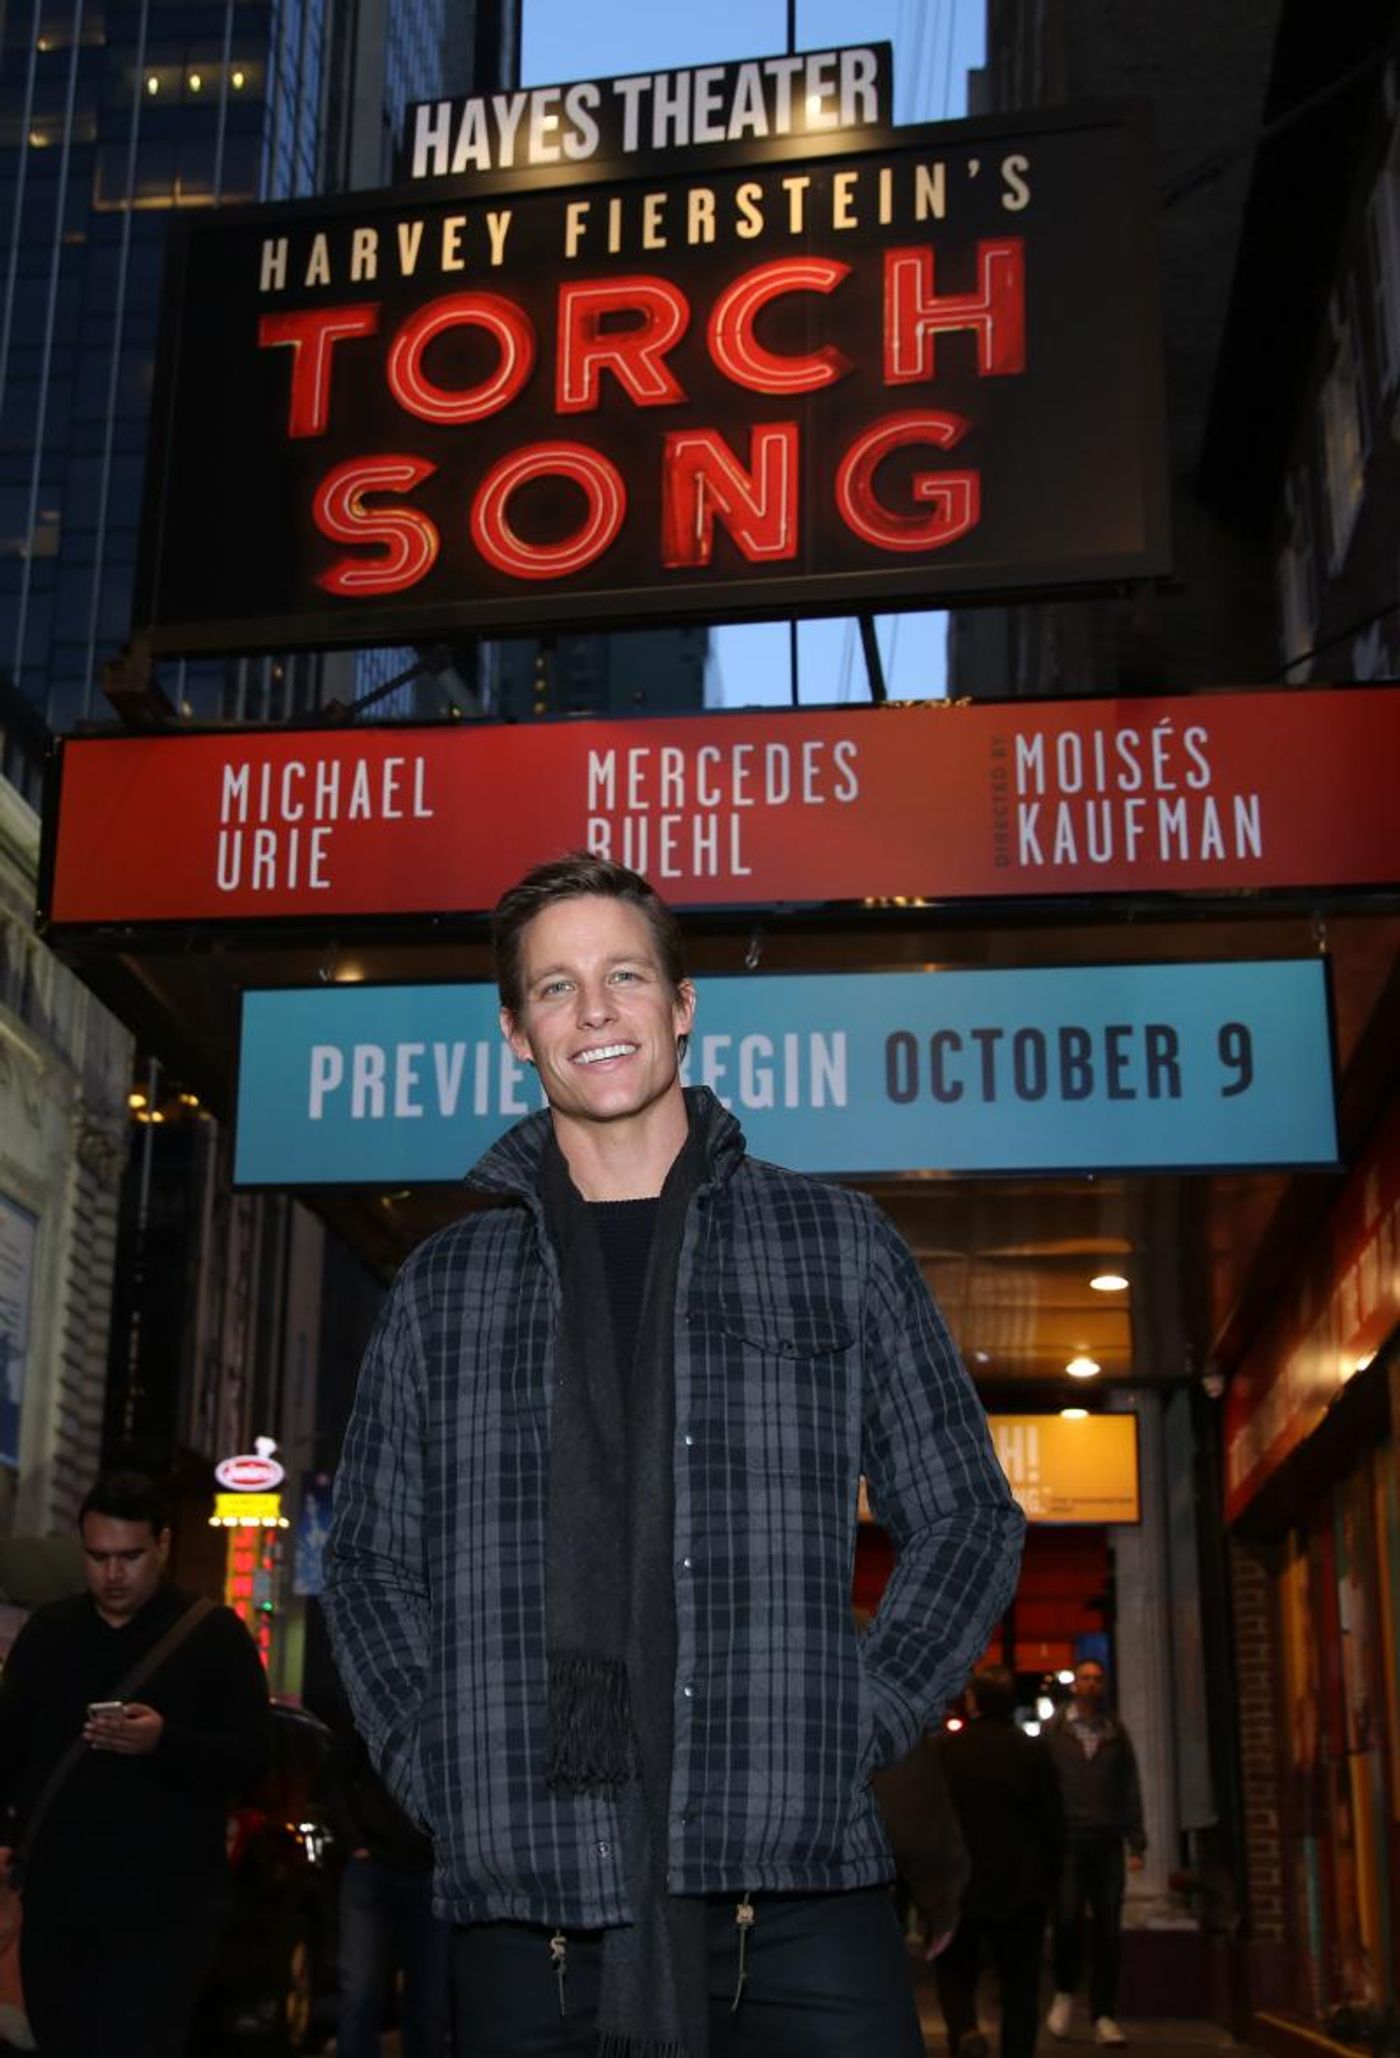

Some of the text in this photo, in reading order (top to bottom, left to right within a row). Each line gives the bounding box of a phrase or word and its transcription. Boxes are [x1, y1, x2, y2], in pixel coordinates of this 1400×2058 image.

[411, 48, 878, 179] HAYES THEATER
[259, 211, 511, 292] HARVEY
[258, 236, 1026, 439] TORCH
[312, 409, 981, 596] SONG
[219, 756, 433, 823] MICHAEL
[586, 740, 860, 811] MERCEDES
[1015, 718, 1212, 796] MOISÉS
[216, 826, 333, 890] URIE
[1018, 794, 1263, 866] KAUFMAN
[308, 1040, 551, 1120] PREVIE
[884, 1023, 1182, 1104] OCTOBER
[1218, 1021, 1254, 1098] 9
